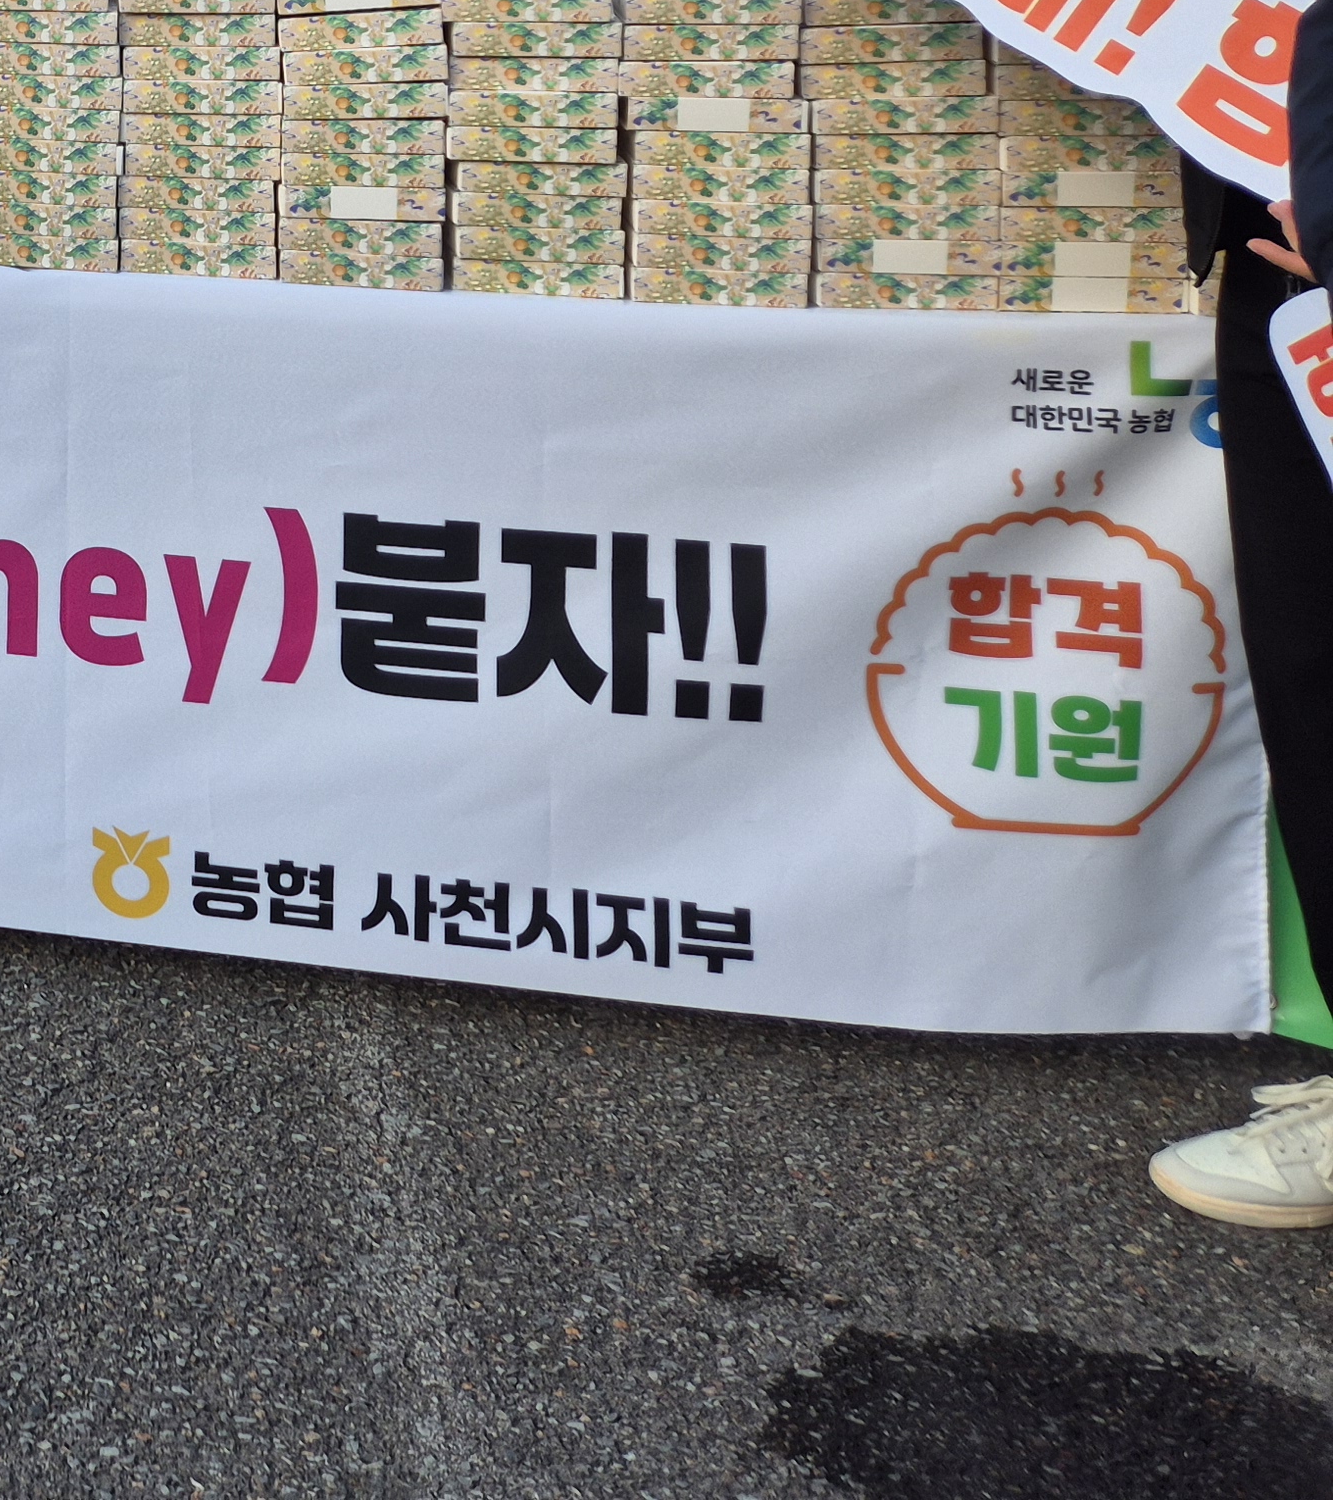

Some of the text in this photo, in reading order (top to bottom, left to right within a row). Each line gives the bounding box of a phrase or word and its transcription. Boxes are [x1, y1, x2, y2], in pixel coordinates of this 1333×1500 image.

[1010, 367, 1095, 396] 새로운
[1010, 404, 1176, 434] 대한민국 농협
[948, 571, 1144, 670] 합격
[943, 686, 1143, 783] 기원
[190, 850, 755, 975] 농협 사천시지부
